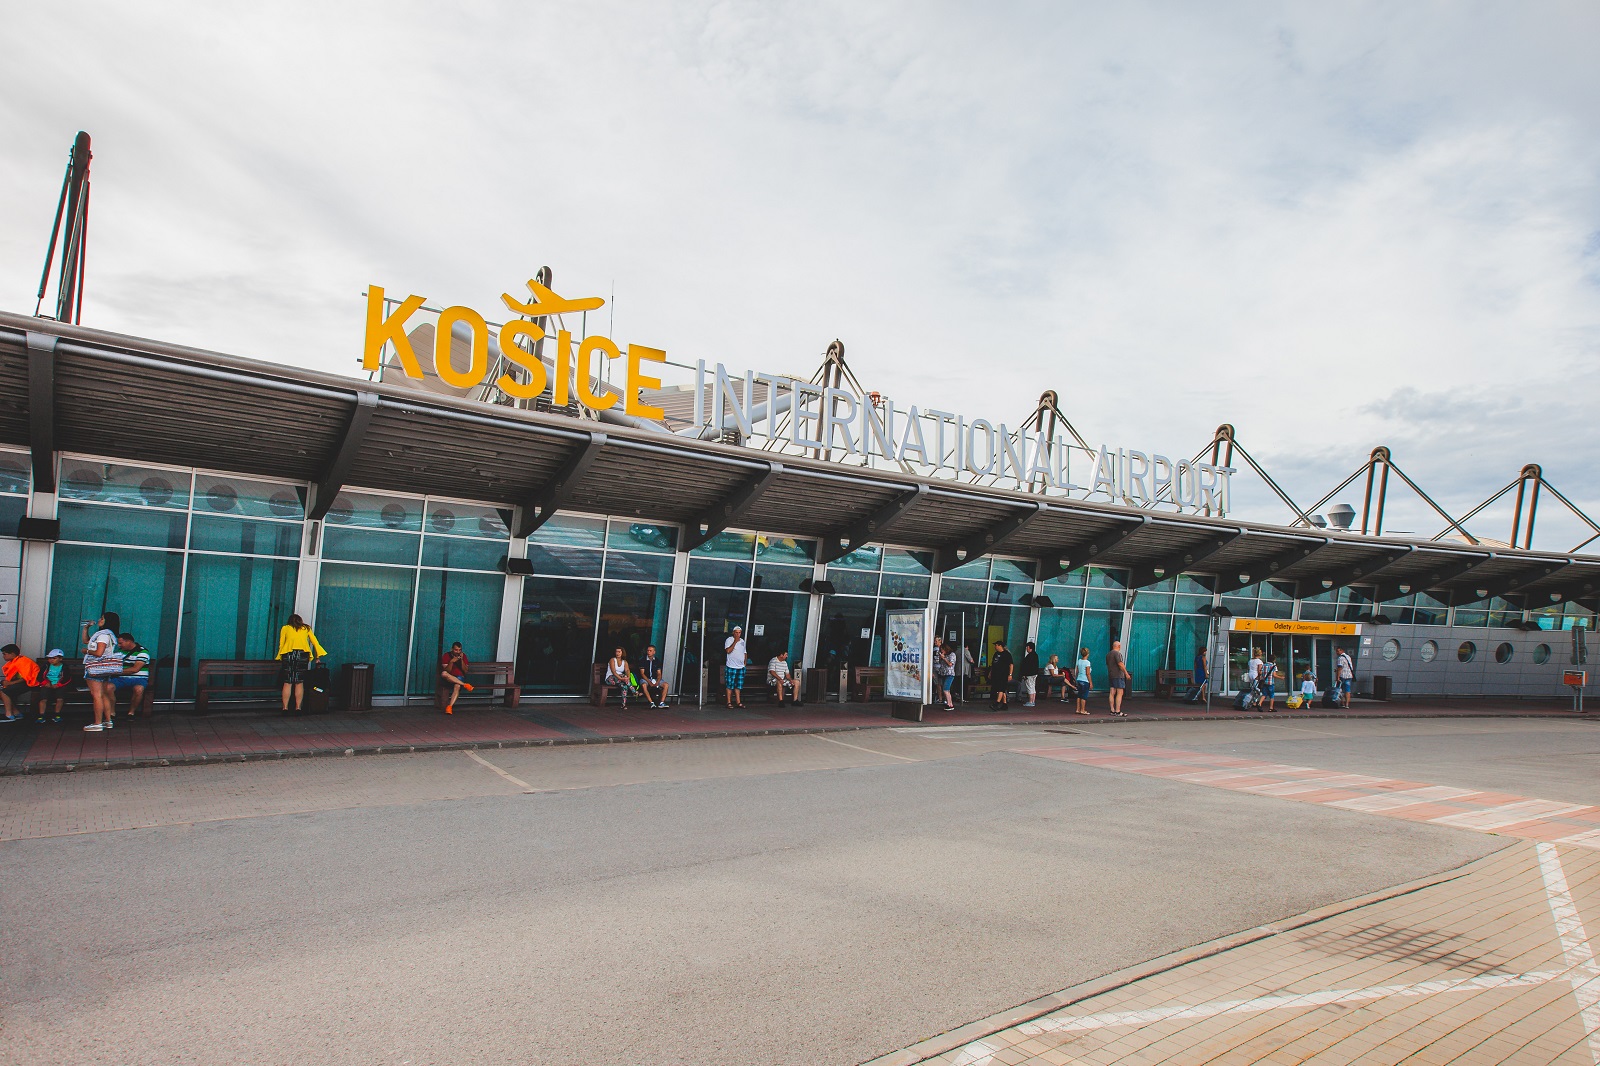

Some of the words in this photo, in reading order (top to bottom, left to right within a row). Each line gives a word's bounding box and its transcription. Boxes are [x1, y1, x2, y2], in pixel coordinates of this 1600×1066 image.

[362, 279, 667, 420] KOŠICE
[694, 359, 1078, 491] INTERNATIONAL
[1090, 444, 1237, 514] AIRPORT
[1274, 623, 1292, 631] Odlety
[892, 650, 919, 663] KOŠICE
